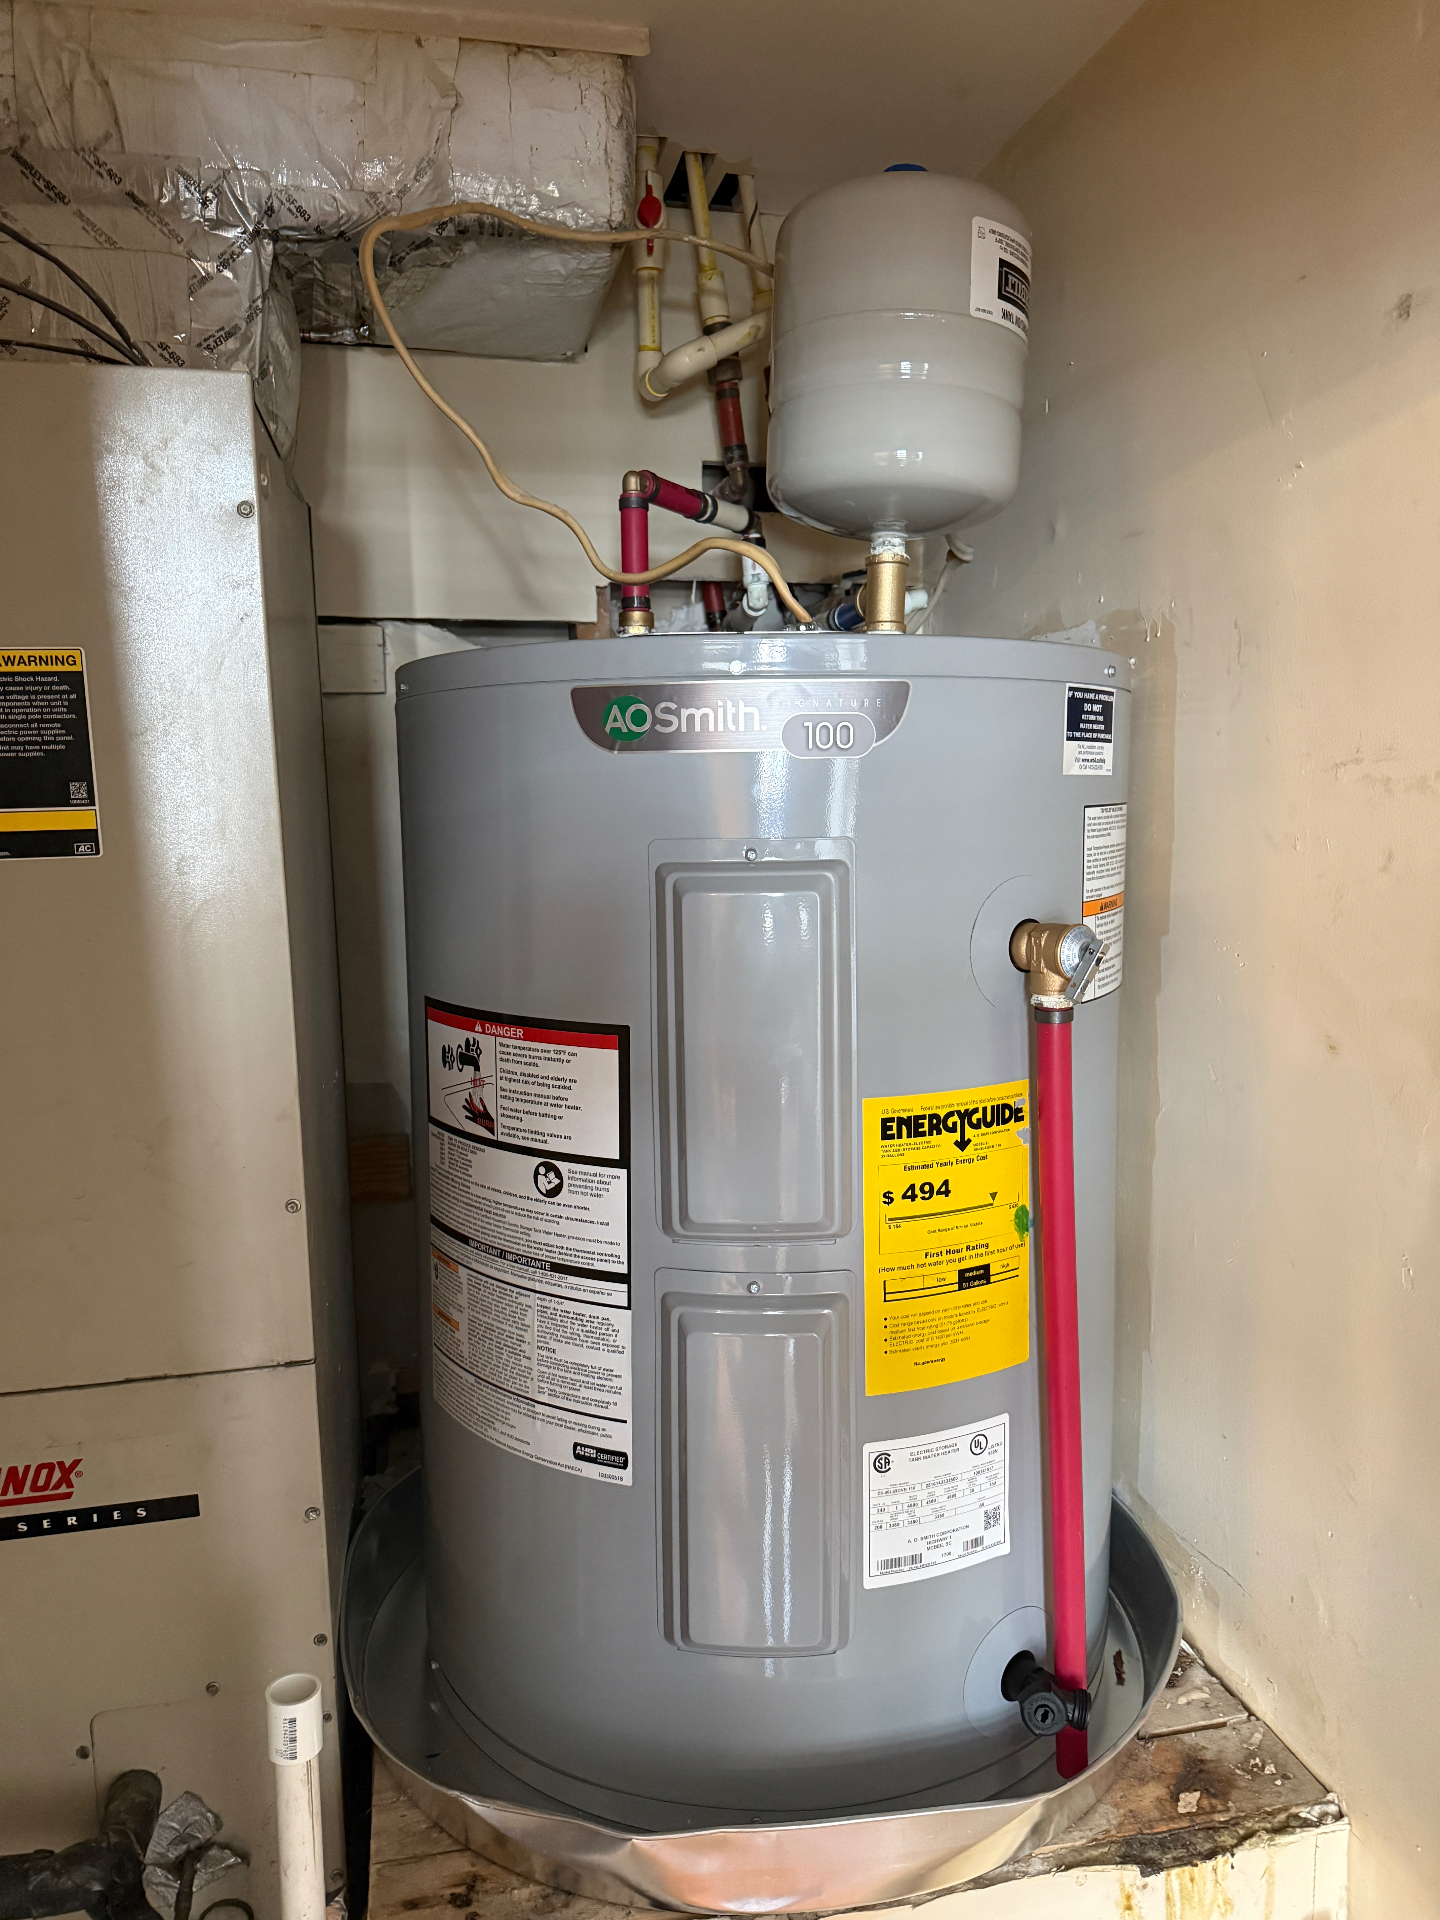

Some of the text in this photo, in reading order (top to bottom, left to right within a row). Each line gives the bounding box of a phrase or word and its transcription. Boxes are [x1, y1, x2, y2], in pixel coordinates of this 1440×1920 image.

[157, 341, 186, 368] SF-683
[2, 655, 77, 667] WARNING
[1074, 691, 1084, 699] YOU
[774, 698, 882, 709] SIGNATURE
[1084, 703, 1102, 713] DO NOT
[803, 721, 854, 750] 100
[485, 1024, 524, 1039] DANGER
[500, 1068, 518, 1077] Children,
[550, 1076, 567, 1084] elderly
[537, 1081, 550, 1089] being
[523, 1109, 537, 1117] before
[477, 1118, 494, 1129] BURN
[881, 1101, 1025, 1141] ENERGYGUIDE
[903, 1154, 988, 1172] Estimated Yearly Energy Cost
[568, 1175, 595, 1184] information
[568, 1183, 594, 1192] preventing
[882, 1179, 951, 1206] $ 494
[534, 1196, 547, 1205] elderly
[574, 1204, 590, 1212] shorter.
[565, 1215, 597, 1225] circumstances.
[468, 1239, 501, 1258] IMPORTANT
[505, 1252, 551, 1271] IMPORTANTE
[573, 1247, 596, 1256] thermostat
[924, 1242, 989, 1259] First Hour Rating
[879, 1266, 895, 1274] (How
[897, 1263, 915, 1272] much
[928, 1259, 944, 1268] water
[945, 1258, 957, 1266] you
[958, 1256, 967, 1264] get
[985, 1249, 996, 1257] first
[997, 1246, 1008, 1254] hour
[965, 1269, 984, 1278] medium
[970, 1279, 986, 1287] Gallons
[537, 1345, 557, 1355] NOTICE
[914, 1357, 946, 1366] ftc.gov/energy
[910, 1442, 958, 1457] ELECTRIC STORAGE
[974, 1439, 984, 1450] UL
[576, 1446, 624, 1463] AHRI CERTIFIED
[0, 1458, 84, 1497] NOX
[17, 1507, 147, 1533] SERIES
[920, 1524, 970, 1541] SMITH CORPORATION
